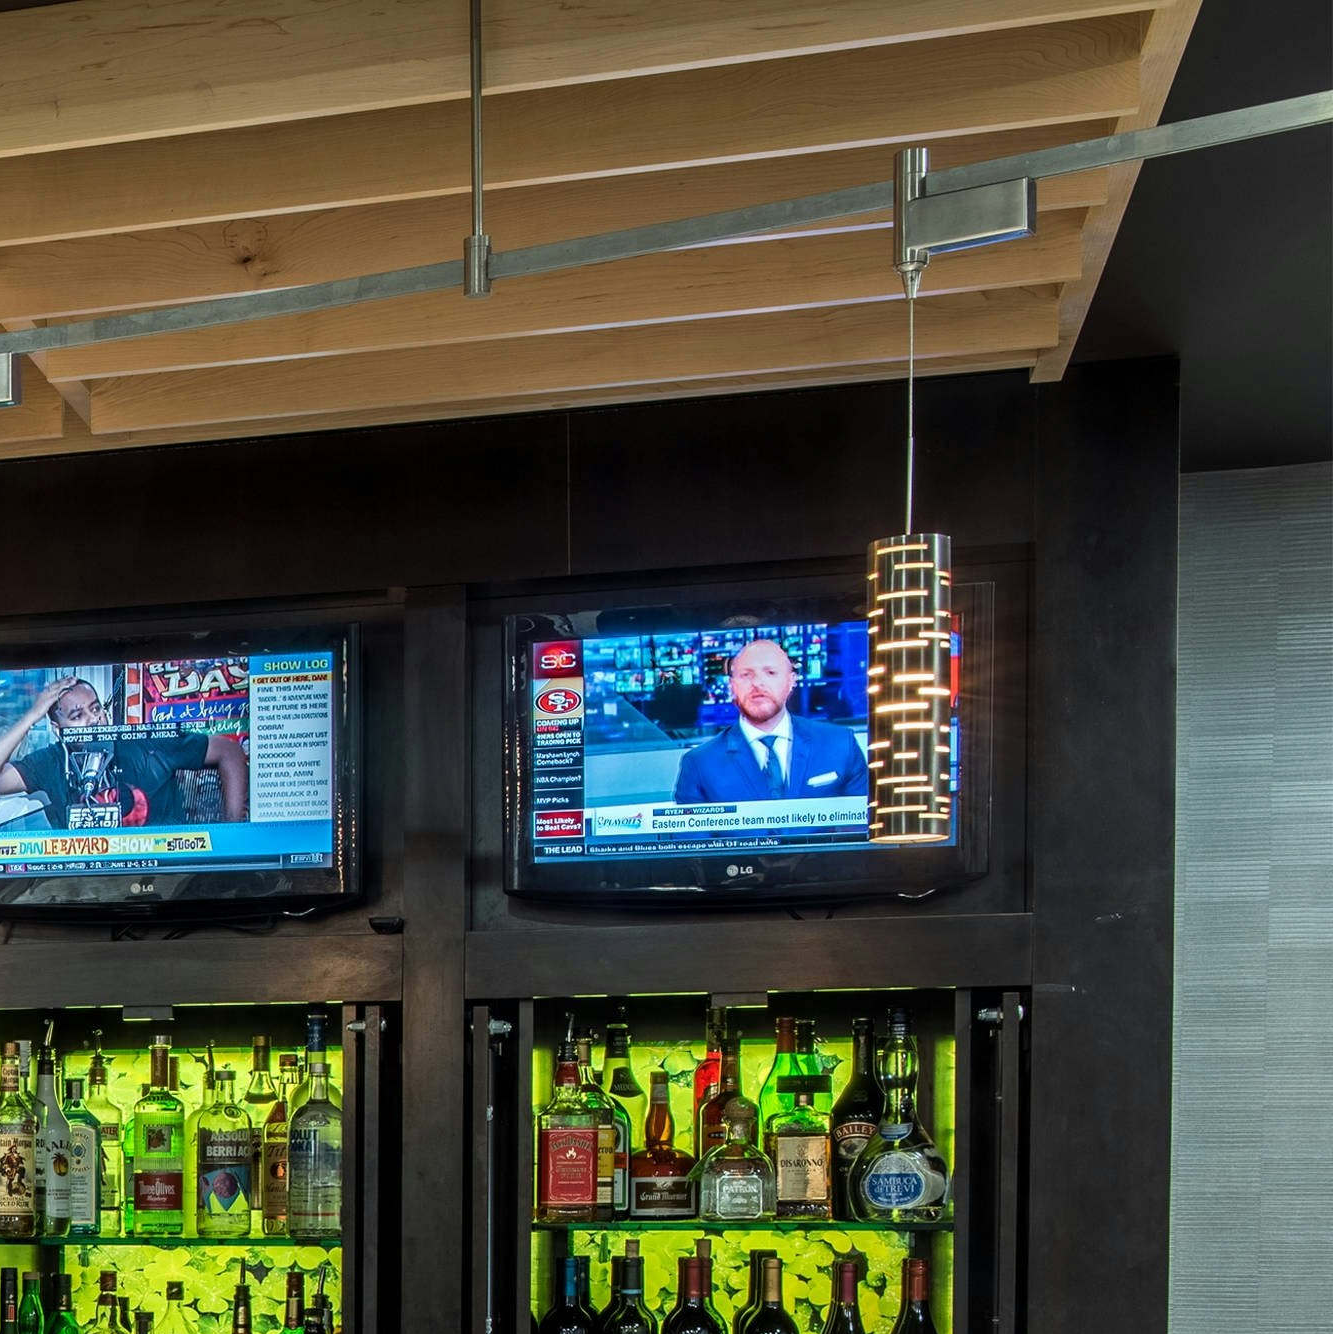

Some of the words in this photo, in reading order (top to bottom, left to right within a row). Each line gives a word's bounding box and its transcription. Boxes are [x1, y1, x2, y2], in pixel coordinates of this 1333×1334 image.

[264, 661, 301, 672] SHOW
[305, 659, 328, 669] LOG
[536, 719, 567, 727] COMING
[63, 734, 93, 743] MOVIES
[97, 733, 118, 742] THAT
[121, 732, 147, 741] GOING
[550, 775, 582, 783] Champion?
[554, 817, 575, 825] Likely
[652, 819, 686, 829] Eastern
[688, 816, 740, 827] Conference
[742, 815, 765, 825] team
[766, 814, 790, 824] most
[791, 812, 815, 824] likely
[817, 812, 827, 822] to
[829, 811, 869, 822] eliminat
[740, 866, 753, 874] LG
[836, 1125, 877, 1139] BAILEY
[780, 1158, 823, 1168] DISARONNO
[871, 1176, 918, 1186] SAMBUCA
